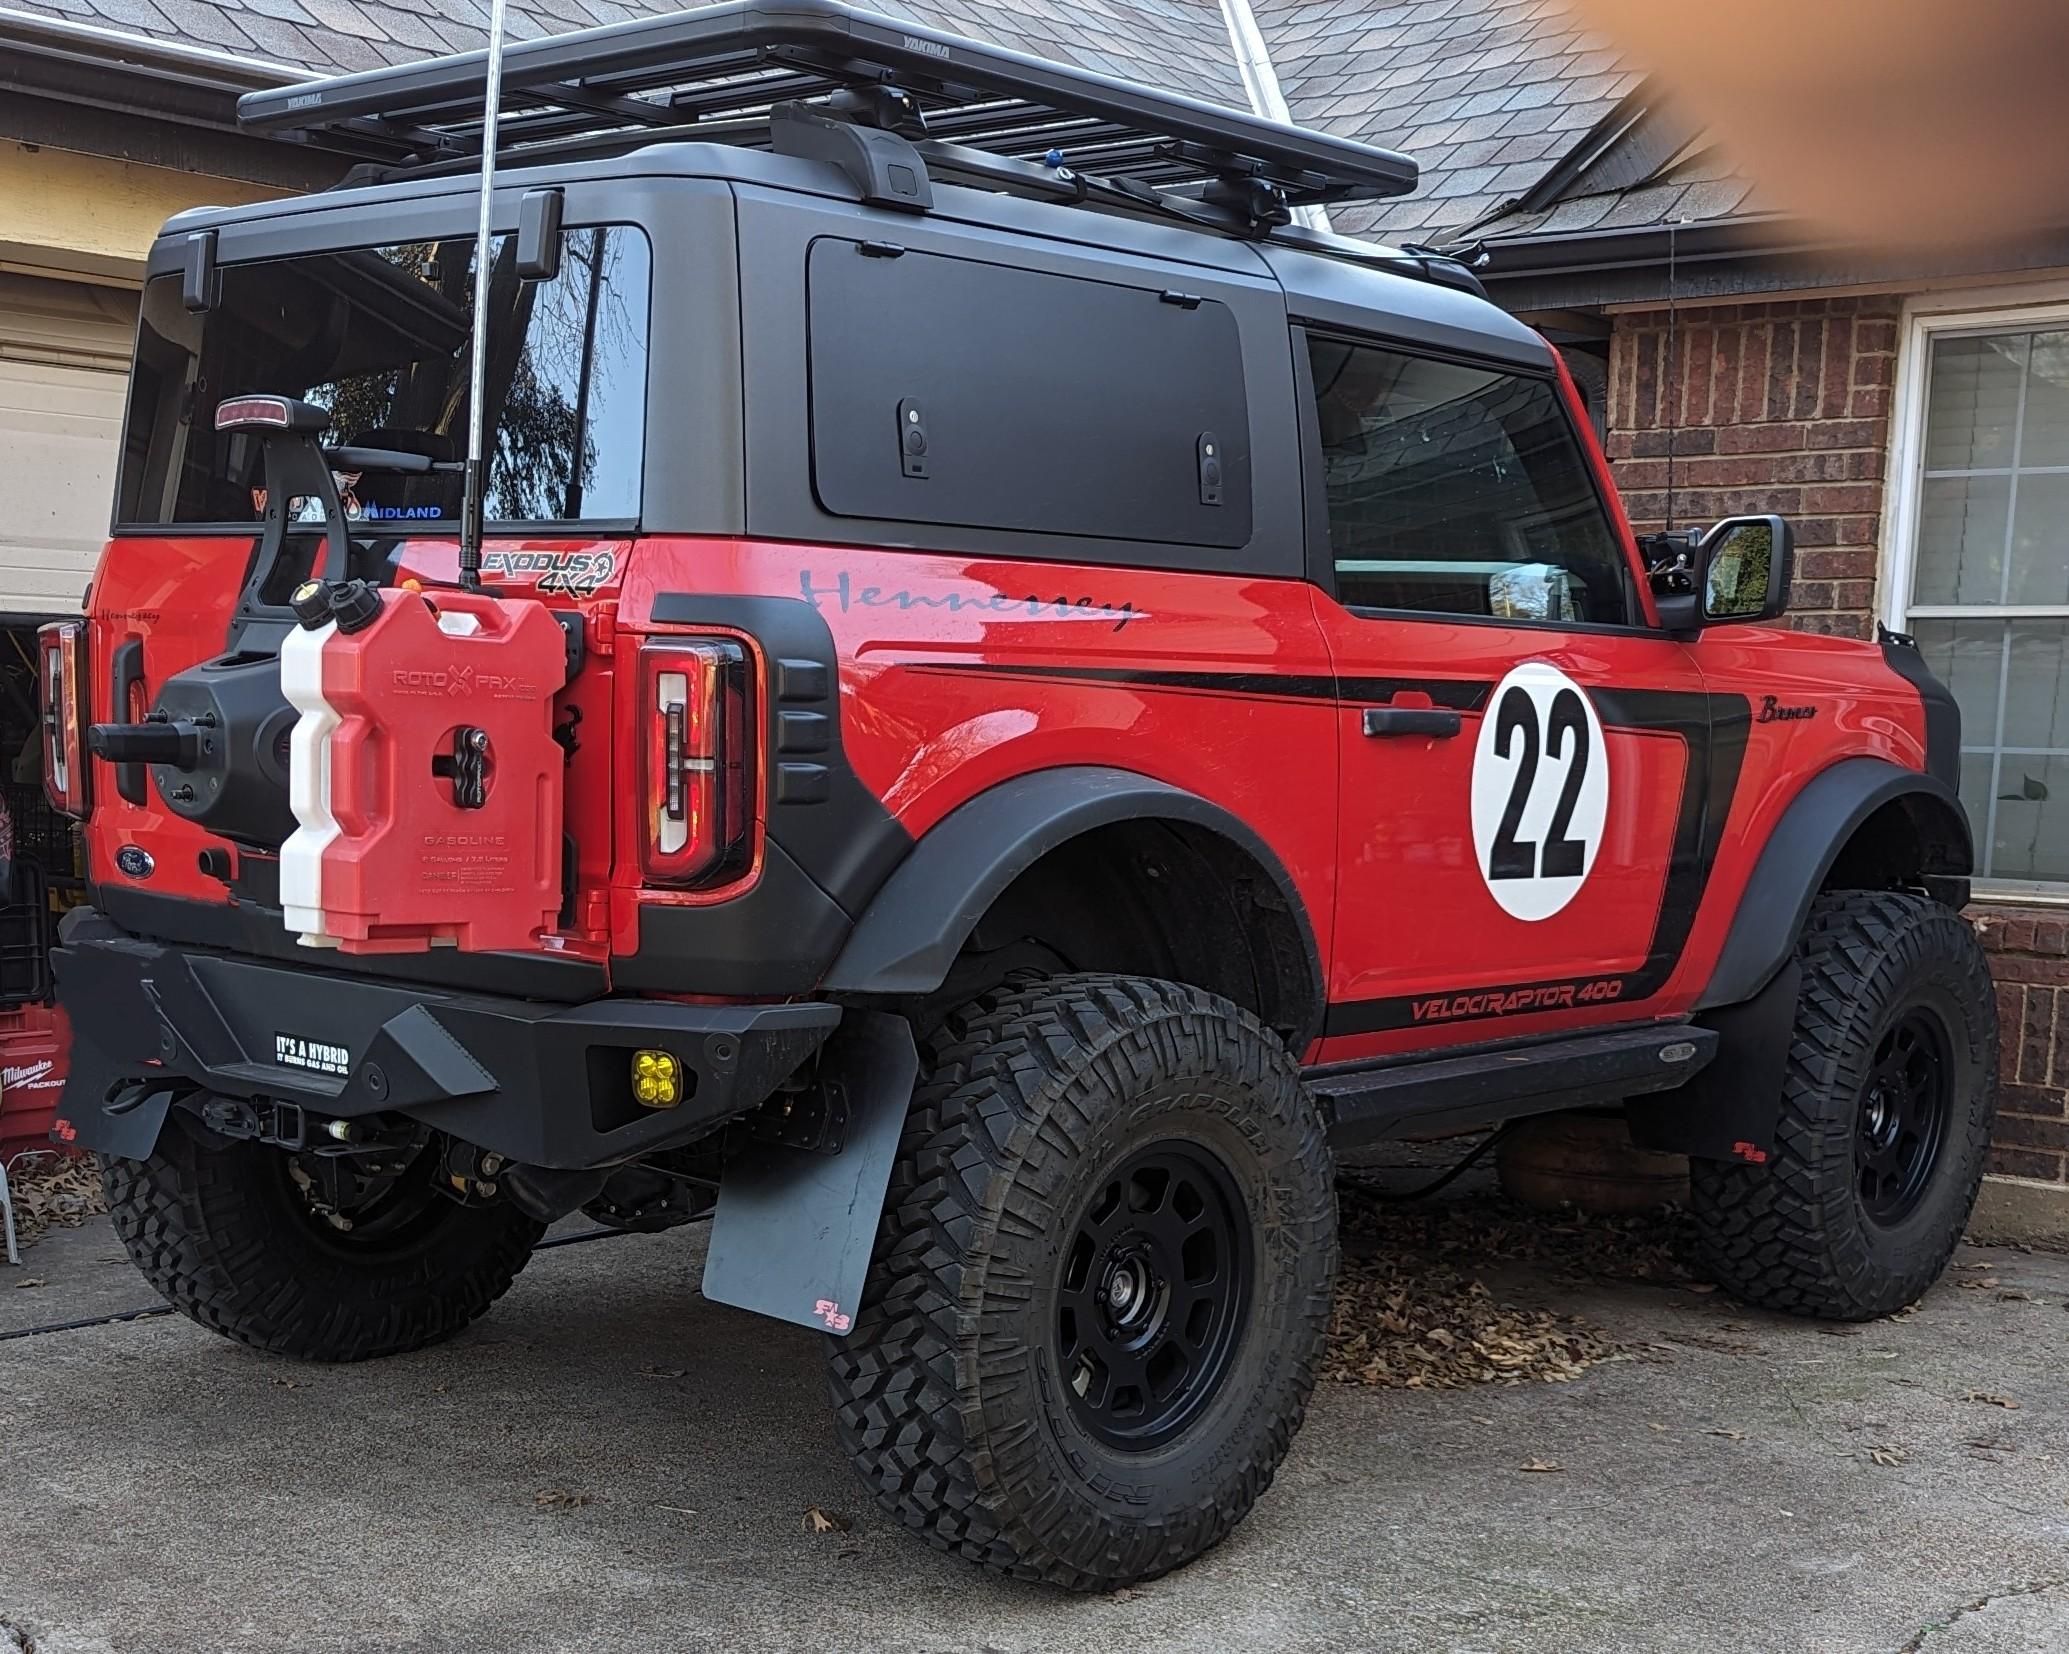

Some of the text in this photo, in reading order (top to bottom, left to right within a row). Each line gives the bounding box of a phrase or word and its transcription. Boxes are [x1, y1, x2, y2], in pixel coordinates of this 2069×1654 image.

[903, 35, 950, 59] YAKIMA
[287, 92, 322, 111] YAKIMA
[364, 500, 442, 519] MIDLAND
[479, 552, 593, 577] EXODUS
[537, 571, 597, 599] 4X4
[799, 570, 1144, 632] Hennessey
[393, 670, 447, 687] ROTO
[1489, 686, 1590, 881] 22
[423, 836, 505, 846] GASOLINE
[1411, 980, 1623, 1020] VELOCIRAPTOR 400
[276, 1035, 349, 1066] IT'S A HYBRID
[1, 1060, 54, 1086] Milwaukee
[276, 1053, 284, 1062] IT
[306, 1059, 321, 1070] GAS
[320, 1061, 336, 1073] AND
[27, 1079, 67, 1090] PACKOUT
